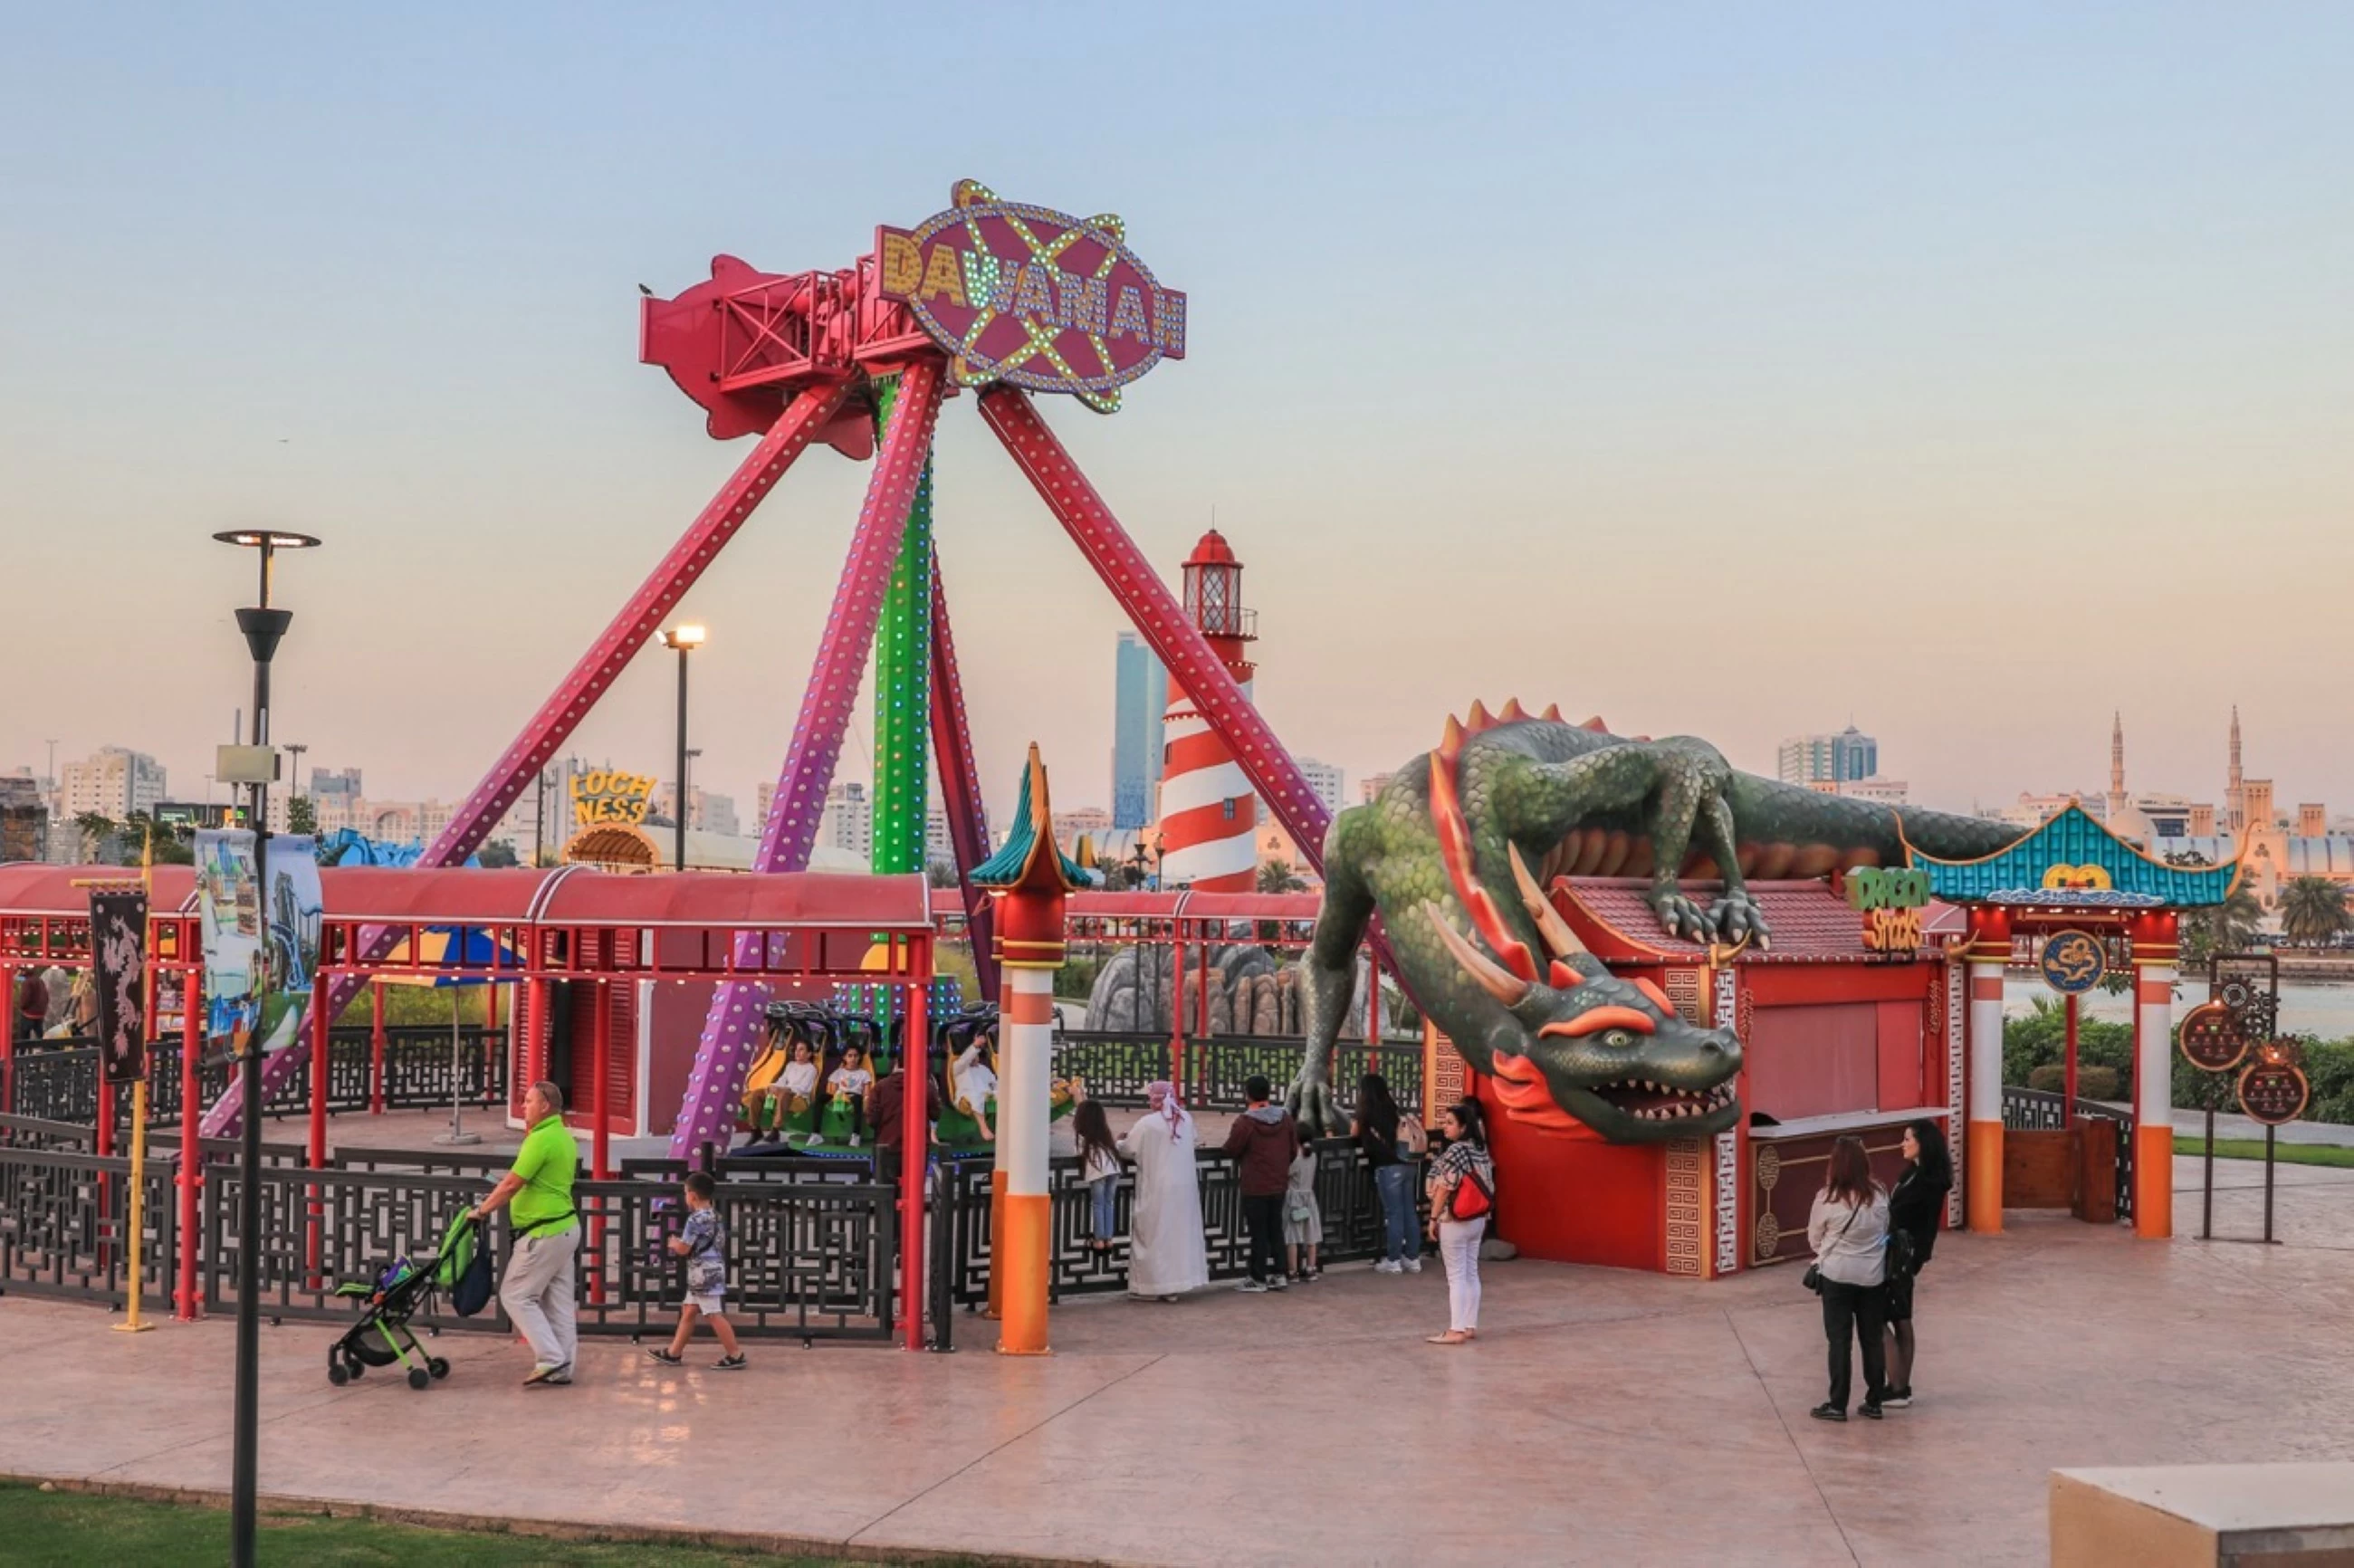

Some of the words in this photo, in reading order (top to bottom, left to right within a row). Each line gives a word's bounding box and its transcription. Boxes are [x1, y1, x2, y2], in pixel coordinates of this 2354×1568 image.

[882, 233, 1185, 351] DAWAMAH
[569, 770, 657, 800] LOCH
[575, 798, 646, 825] NESS
[1854, 866, 1930, 910] DRAGON
